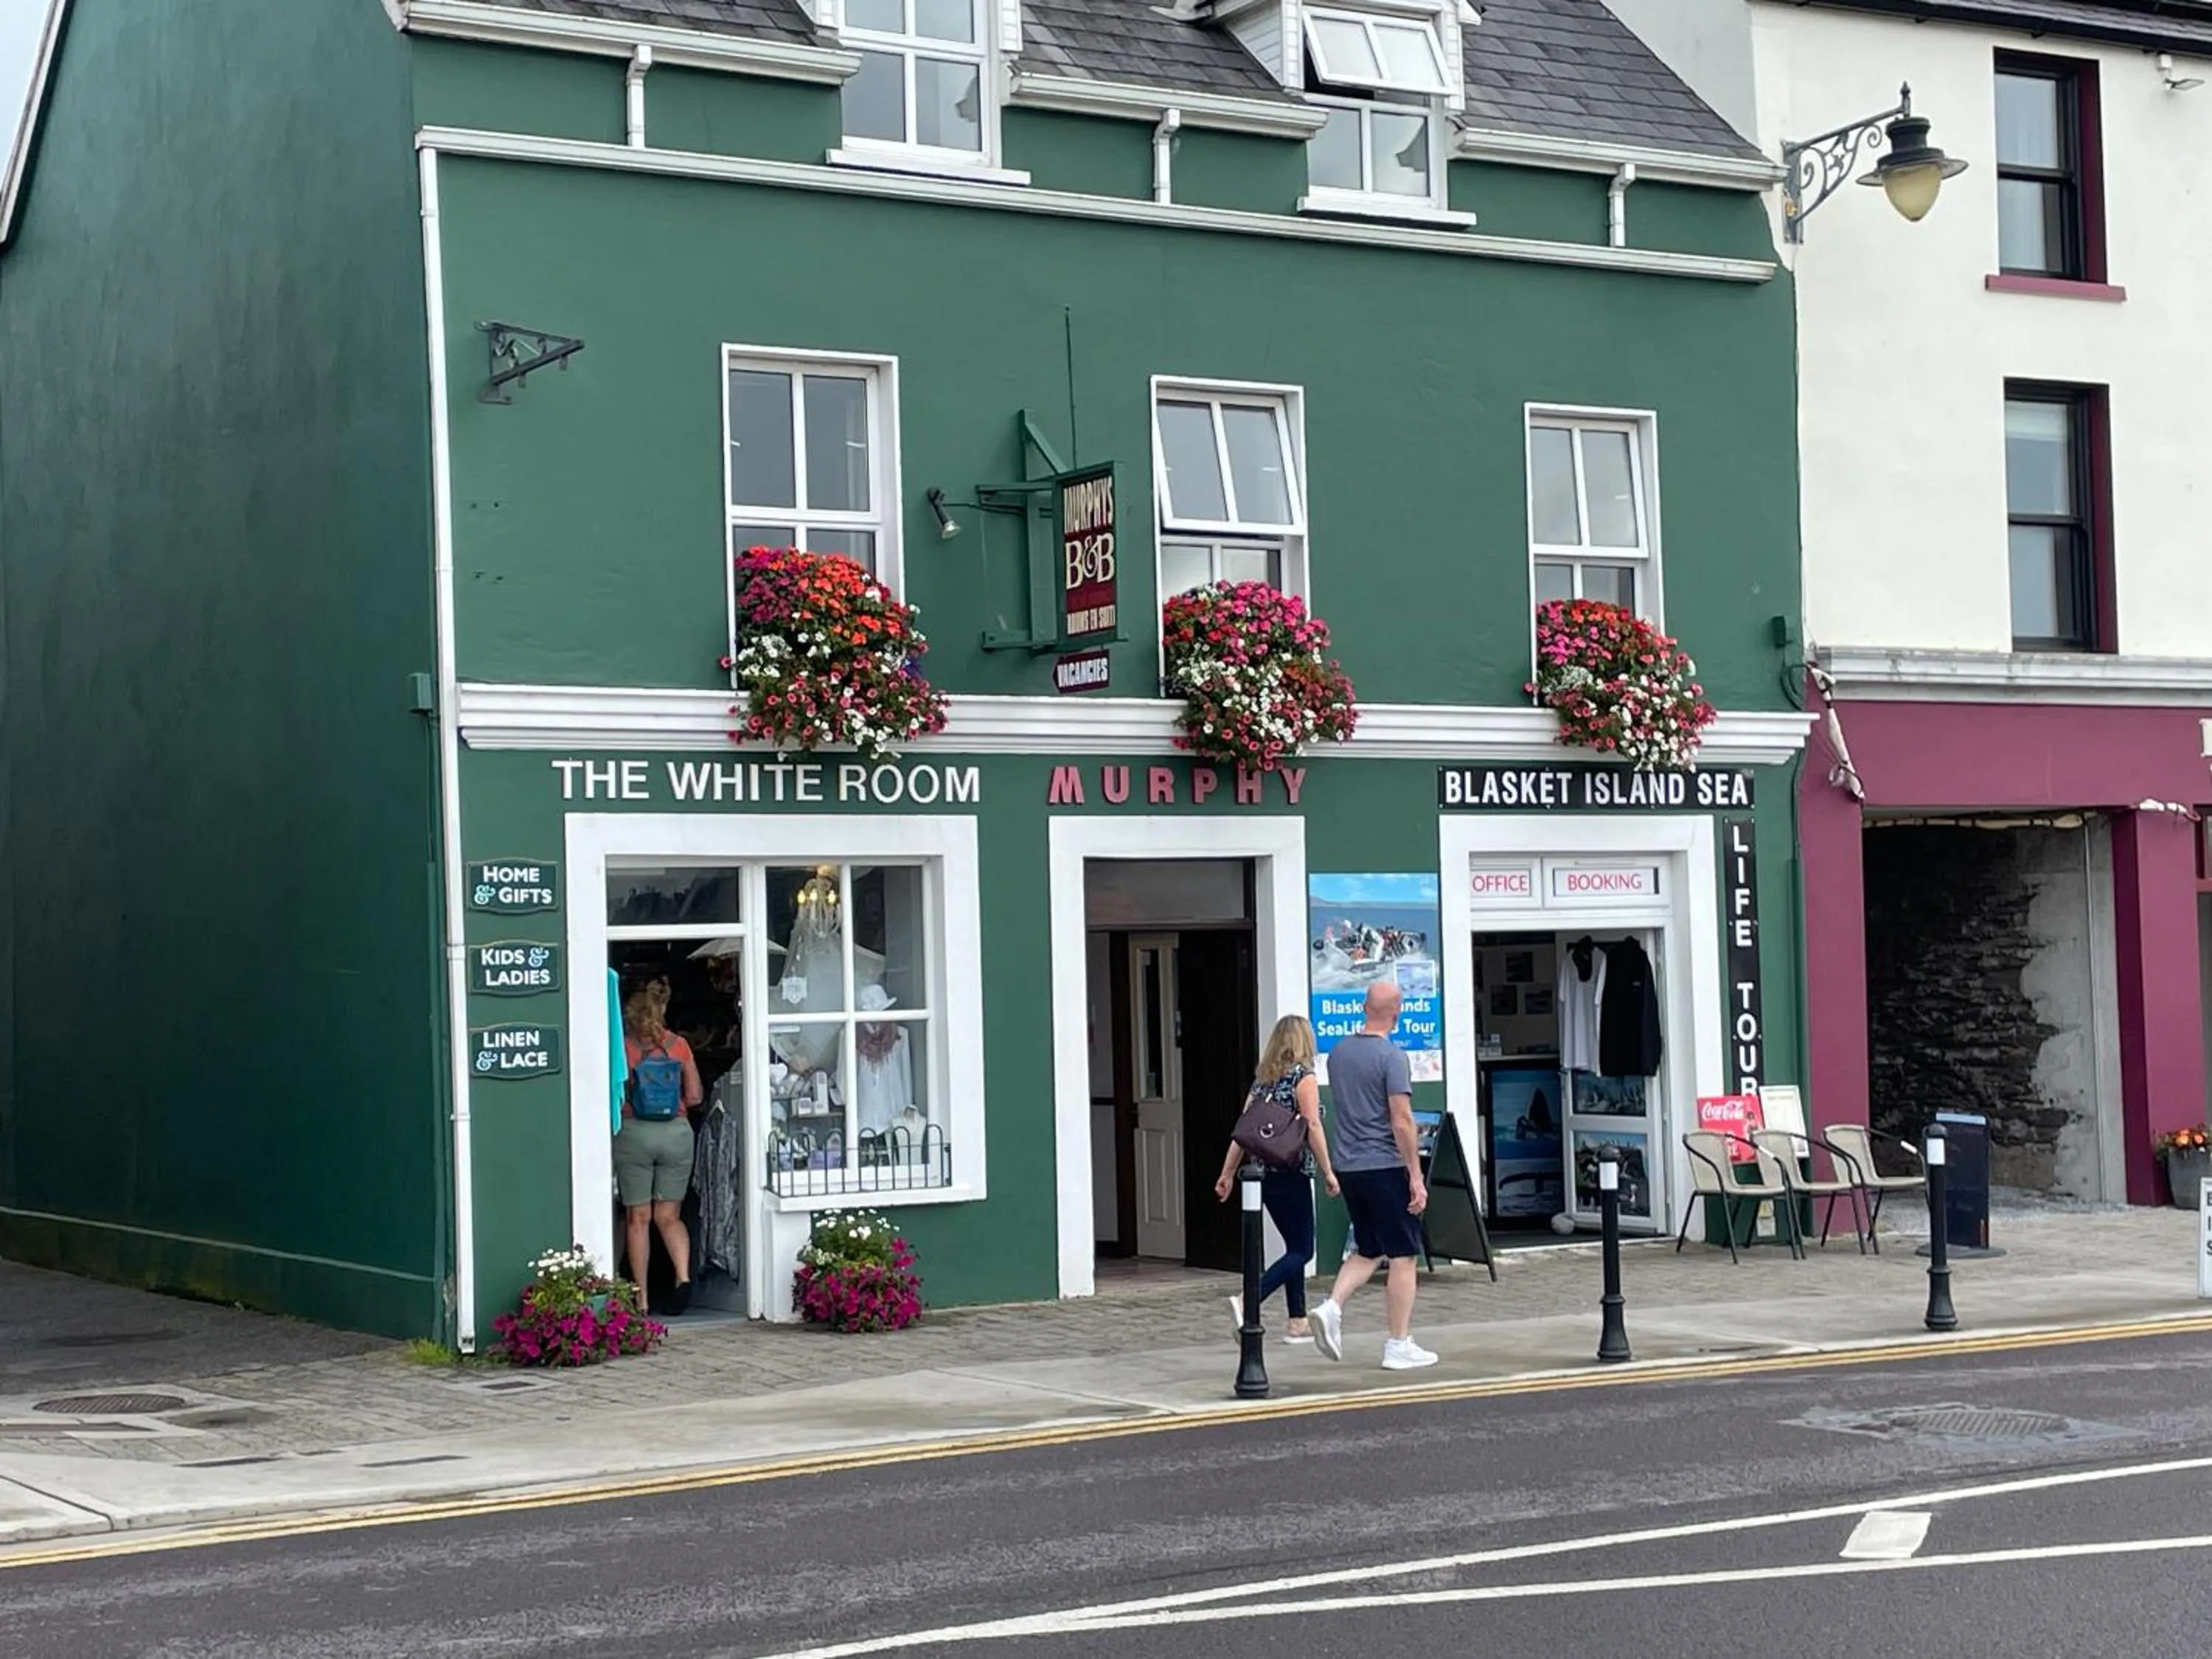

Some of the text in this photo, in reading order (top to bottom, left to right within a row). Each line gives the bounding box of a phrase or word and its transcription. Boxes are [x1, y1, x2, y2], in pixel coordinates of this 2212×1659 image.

[1065, 532, 1115, 590] B&B
[1057, 658, 1108, 687] VACANCIES
[552, 759, 980, 803] THE WHITE ROOM
[1048, 765, 1306, 804] MURPHY
[1445, 771, 1748, 804] BLASKET ISLAND SEA
[483, 866, 540, 883] HOME
[1472, 874, 1528, 891] OFFICE
[1568, 873, 1642, 891] BOOKING
[474, 885, 552, 905] & GIFTS
[1733, 825, 1753, 947] LIFE
[481, 947, 549, 967] KIDS &
[485, 970, 551, 986] LADIES
[1322, 999, 1364, 1015] Blask
[1403, 1018, 1436, 1033] Tour
[483, 1032, 540, 1048] LINEN
[476, 1051, 548, 1071] & LACE
